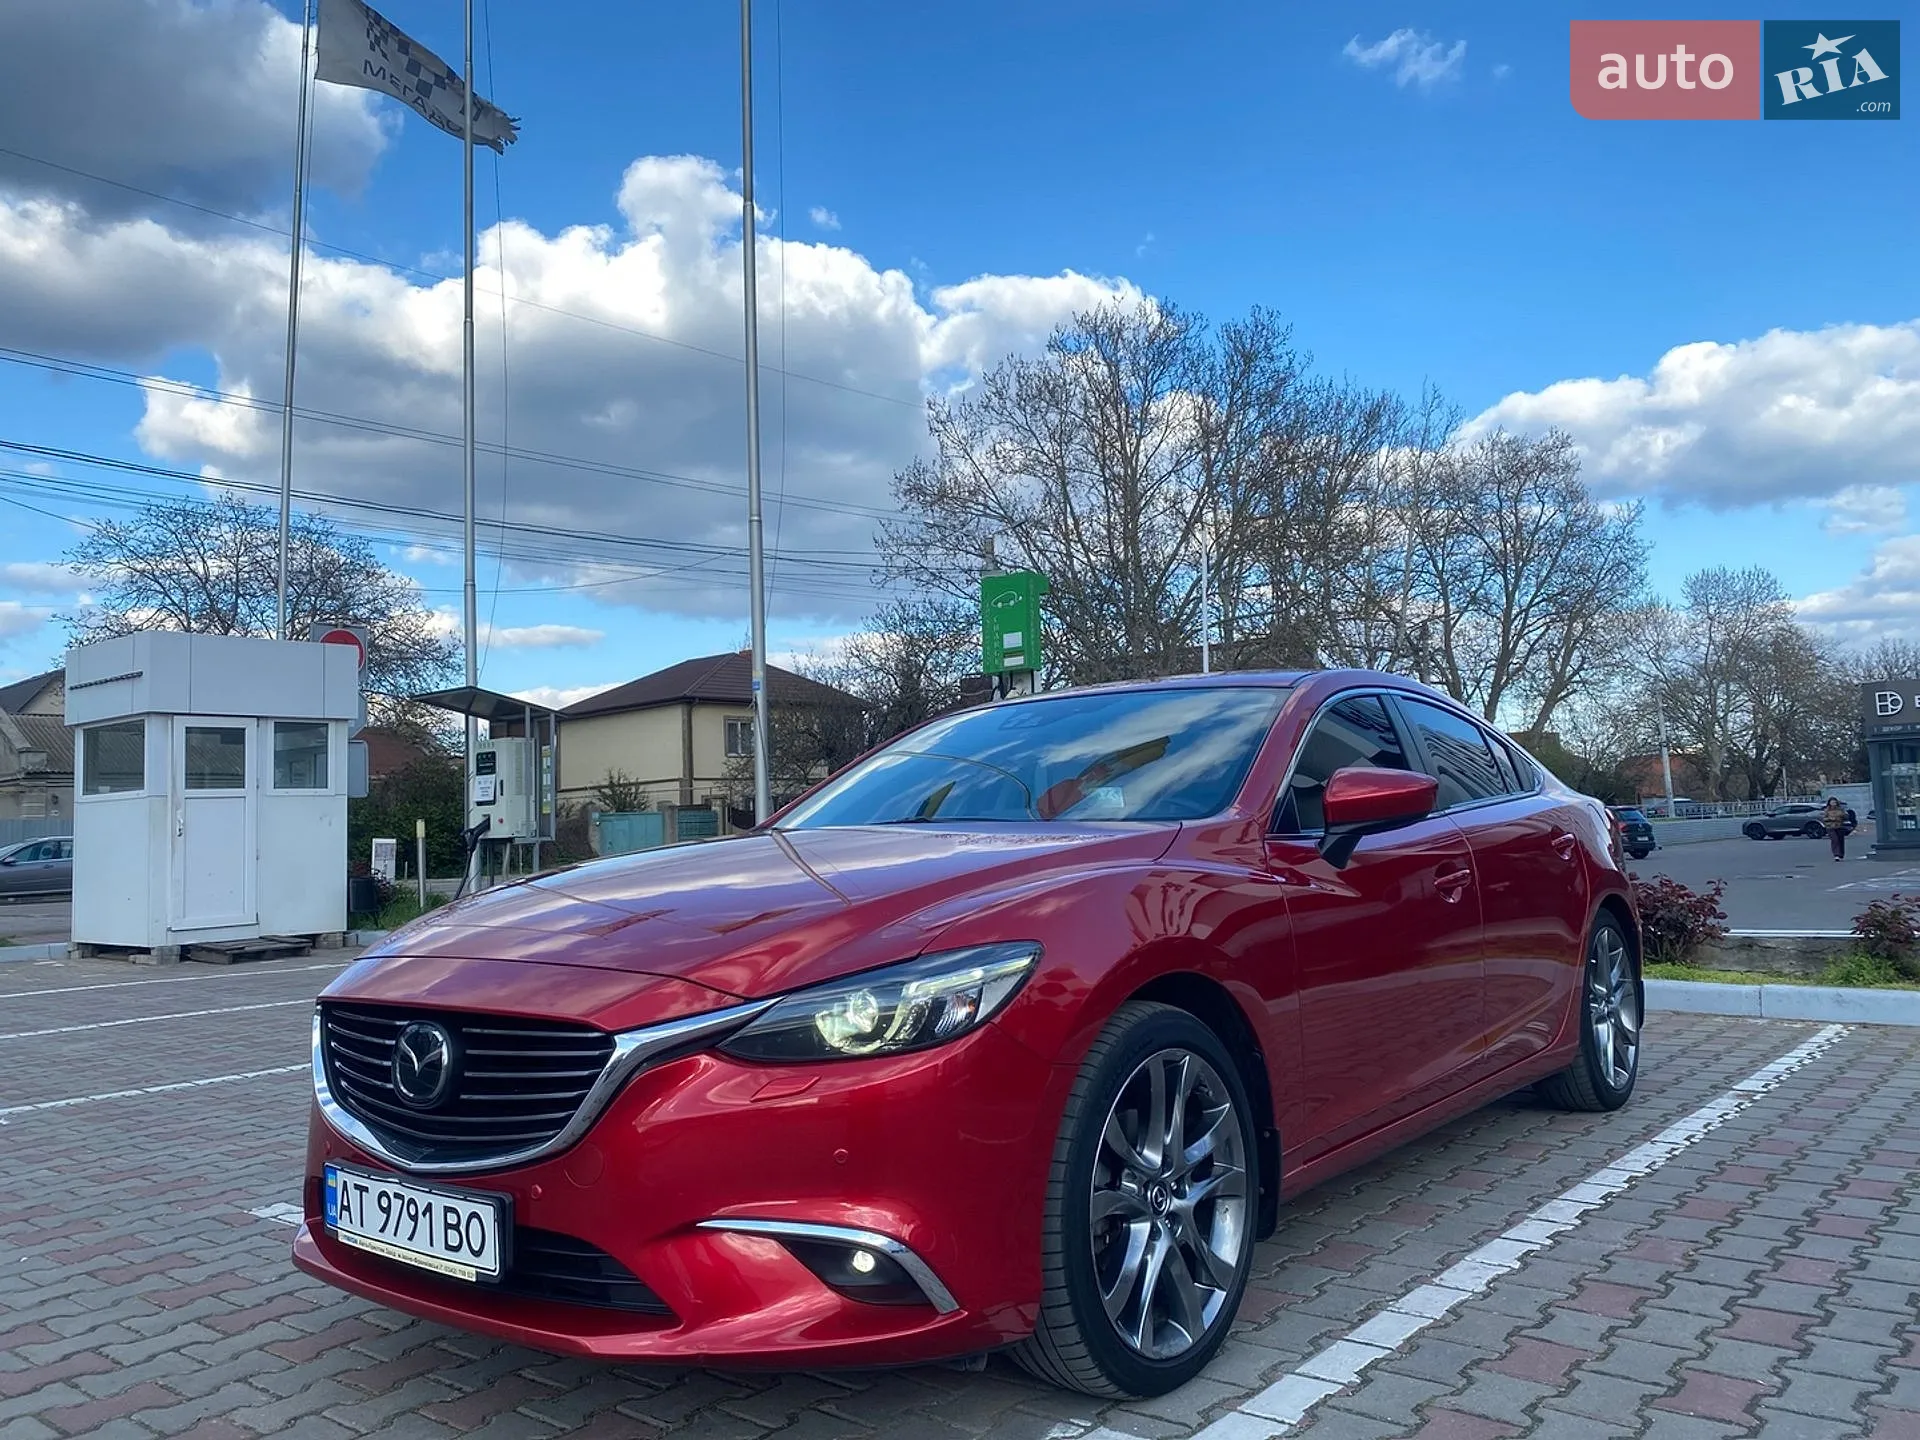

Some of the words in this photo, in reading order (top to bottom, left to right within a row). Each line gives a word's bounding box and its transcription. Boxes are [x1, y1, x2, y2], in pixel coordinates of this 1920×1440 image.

[328, 1204, 337, 1216] UA
[338, 1179, 369, 1228] AT
[377, 1189, 434, 1248] 9791
[443, 1205, 486, 1258] BO
